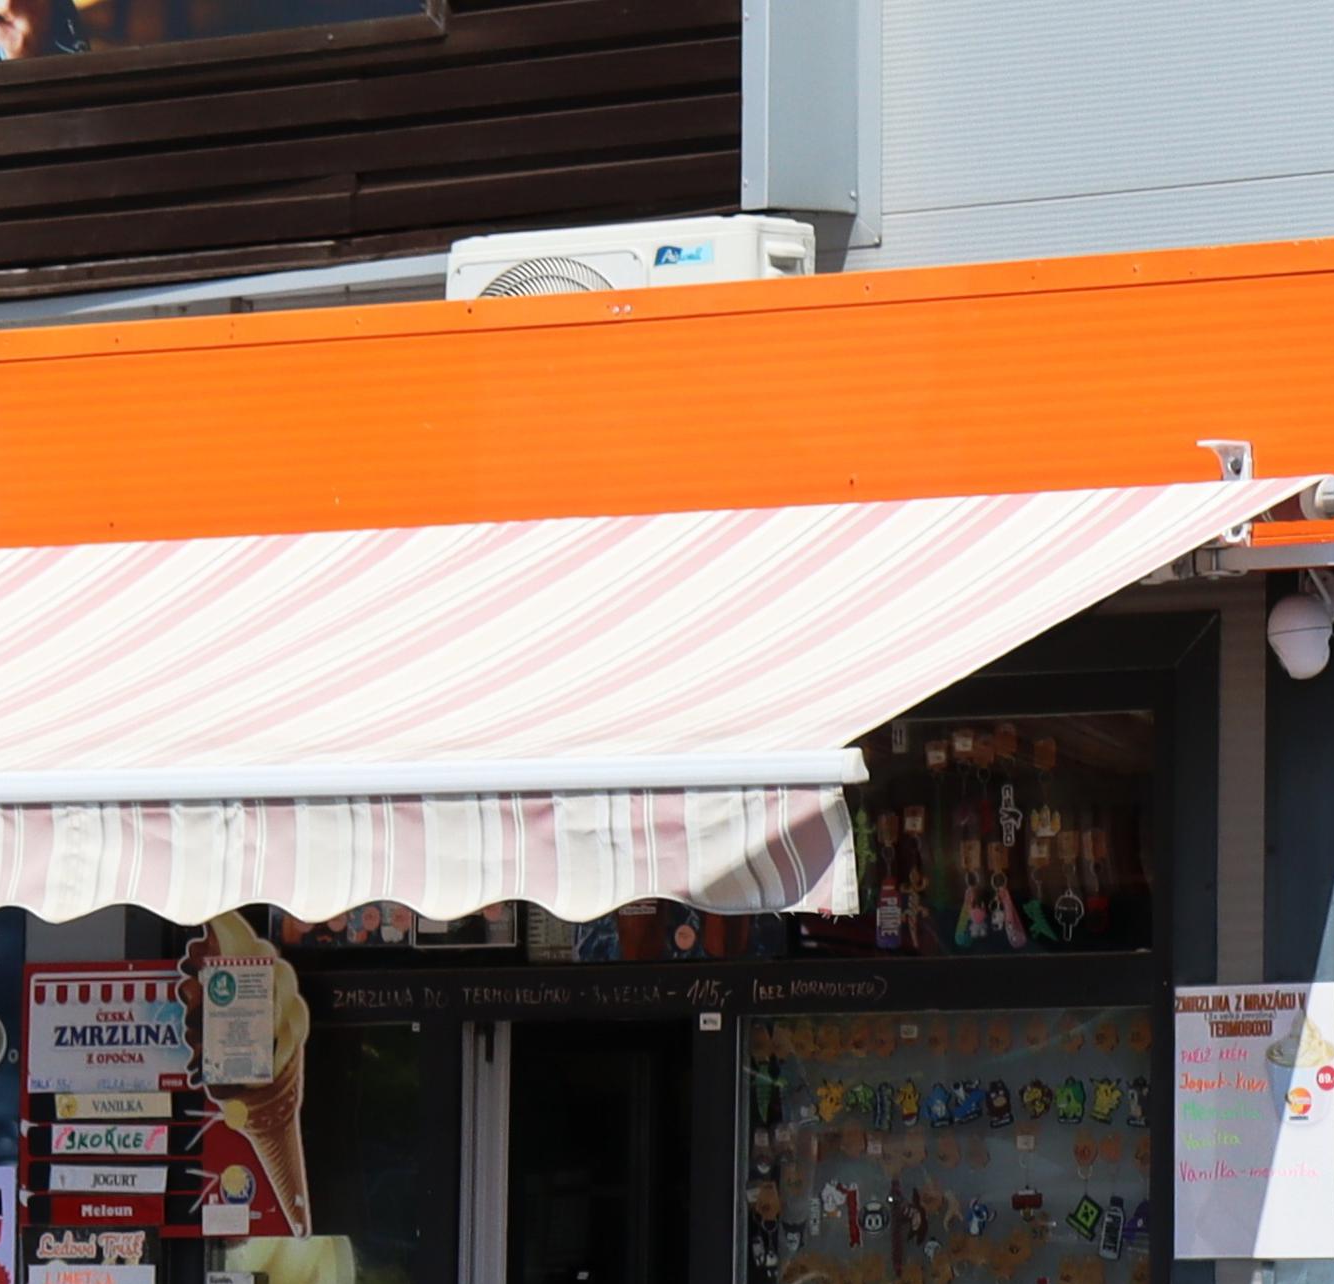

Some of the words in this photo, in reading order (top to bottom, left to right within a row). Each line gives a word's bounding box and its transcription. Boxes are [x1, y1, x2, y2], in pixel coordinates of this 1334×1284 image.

[95, 1009, 134, 1022] ČESKÁ
[54, 1024, 179, 1047] ZMRZLINA
[86, 1053, 95, 1065] Z
[95, 1051, 145, 1065] OPOČNA
[91, 1099, 144, 1113] VANILKA
[91, 1174, 138, 1188] JOGURT
[80, 1203, 134, 1218] Meloun
